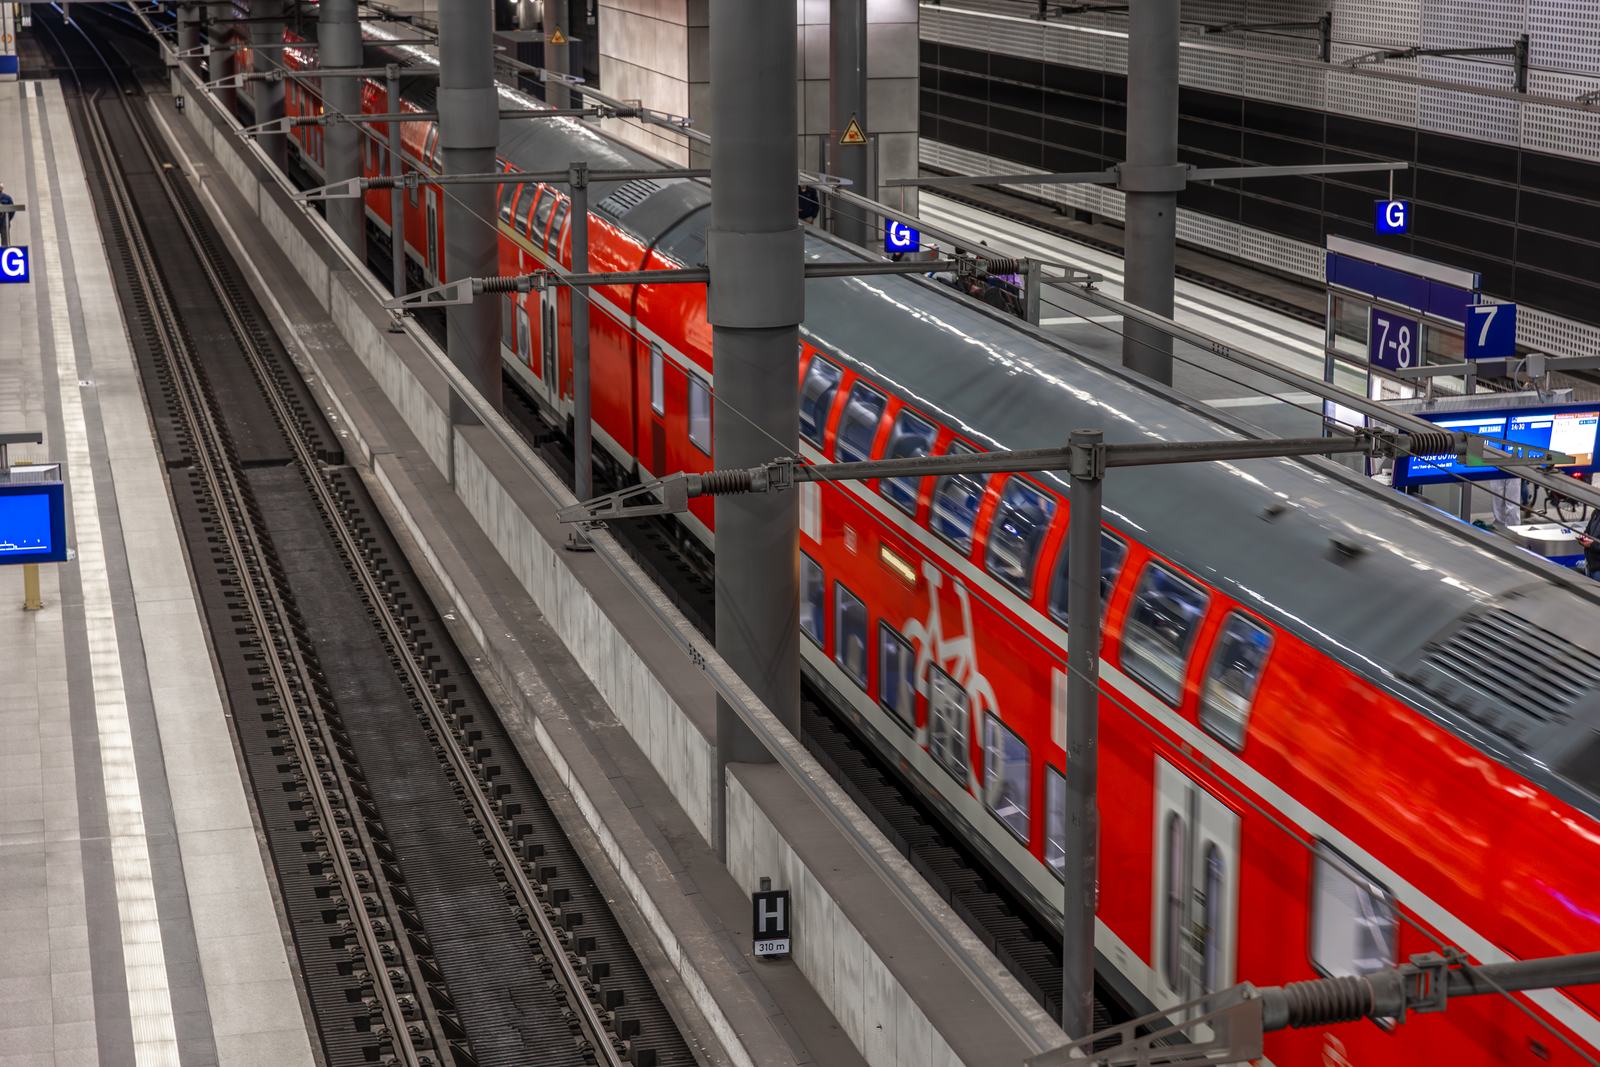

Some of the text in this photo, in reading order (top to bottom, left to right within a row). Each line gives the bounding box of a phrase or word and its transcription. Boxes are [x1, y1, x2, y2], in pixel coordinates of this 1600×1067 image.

[176, 97, 184, 107] H
[1386, 201, 1404, 228] G
[890, 221, 911, 246] G
[1, 247, 25, 277] G
[1474, 305, 1498, 347] 7
[1377, 317, 1411, 368] 7-8
[758, 897, 784, 932] H
[759, 943, 785, 951] 310 m
